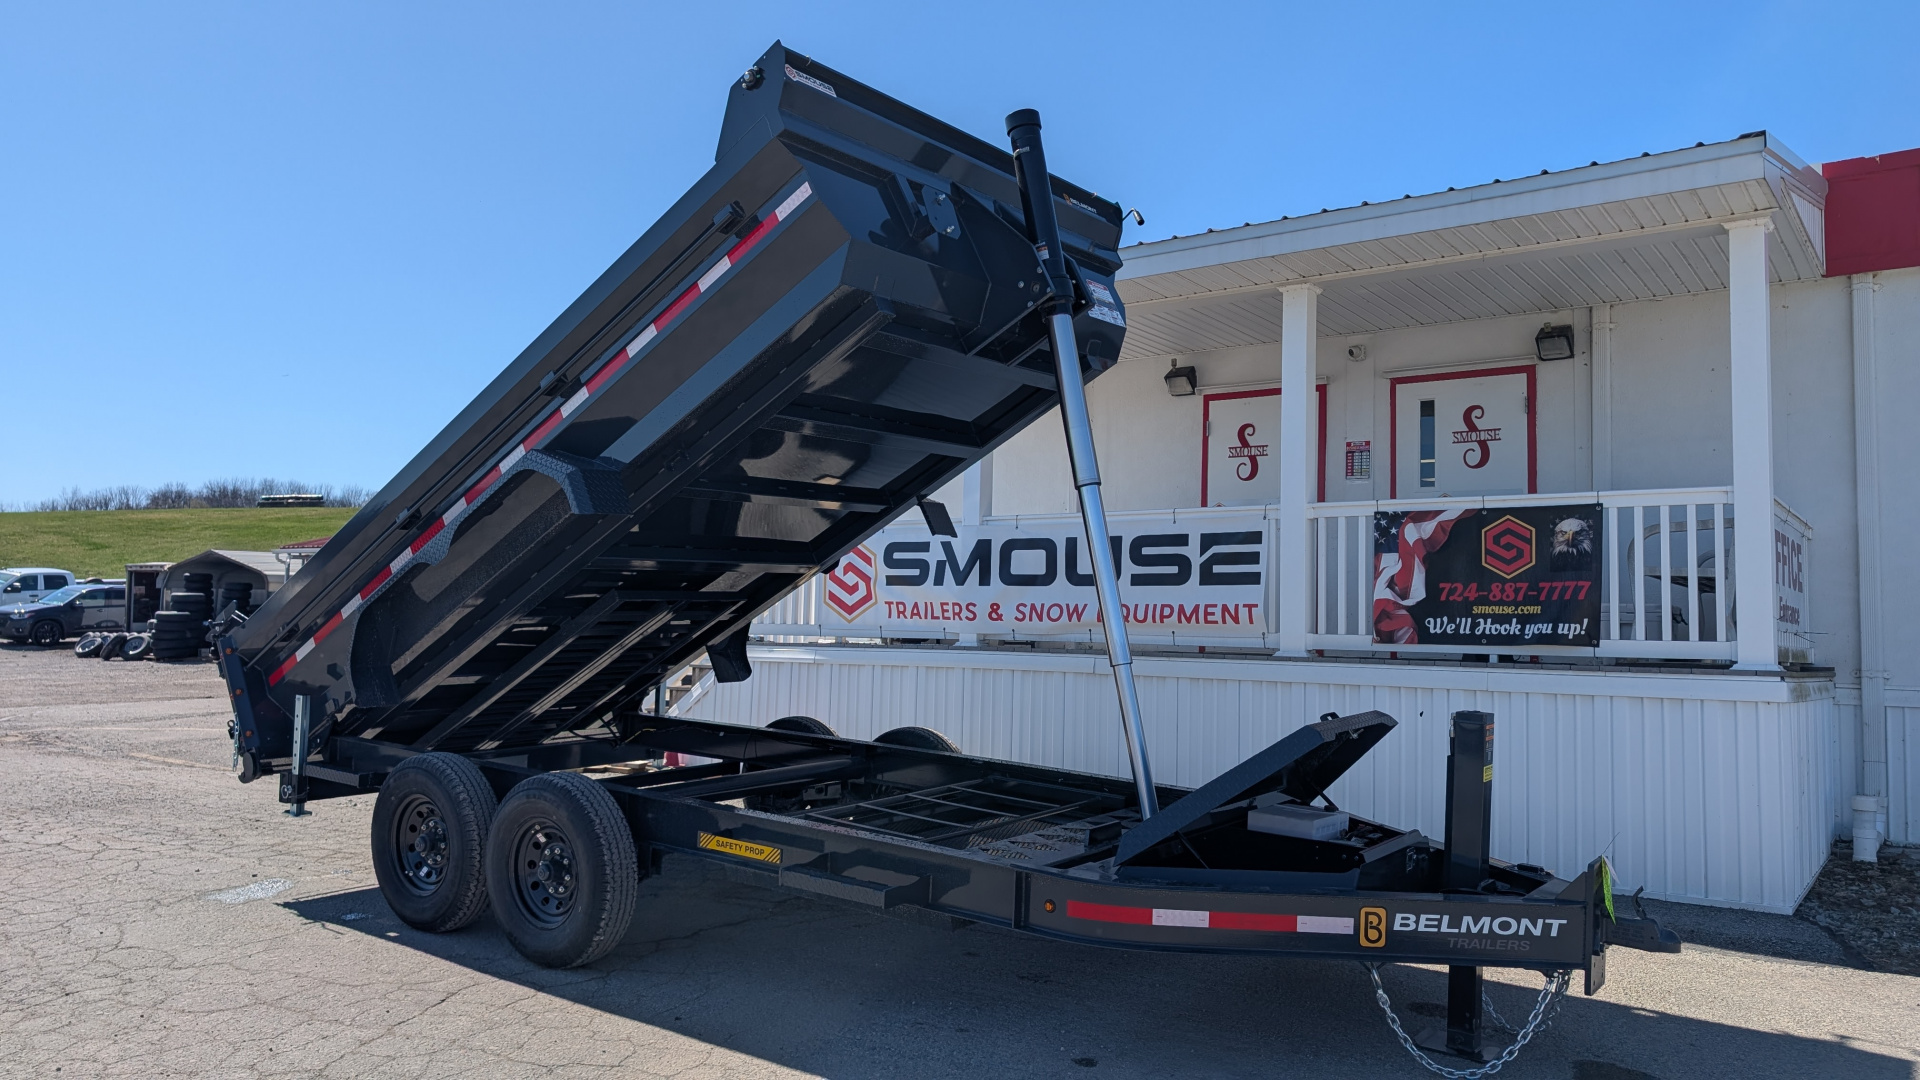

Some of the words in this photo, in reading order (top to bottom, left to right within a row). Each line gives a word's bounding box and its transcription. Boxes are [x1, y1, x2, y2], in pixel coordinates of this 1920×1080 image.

[1452, 430, 1501, 443] SMOUSE
[1228, 446, 1268, 458] SMOUSE
[883, 531, 1262, 587] SMOUSE
[1774, 528, 1803, 593] FFICE
[1438, 581, 1592, 602] 724-887-7777
[884, 601, 977, 622] TRAILERS
[987, 602, 1004, 622] &
[1014, 602, 1088, 623] SNOW
[1472, 604, 1542, 615] smouse.com
[1425, 616, 1471, 635] We'll
[1475, 617, 1521, 636] Hook
[1524, 622, 1553, 639] you
[1558, 618, 1589, 639] up!
[715, 839, 743, 851] SAFETY
[744, 845, 765, 856] PROP
[1393, 913, 1567, 937] BELMONT
[1447, 937, 1531, 951] TRAILERS
